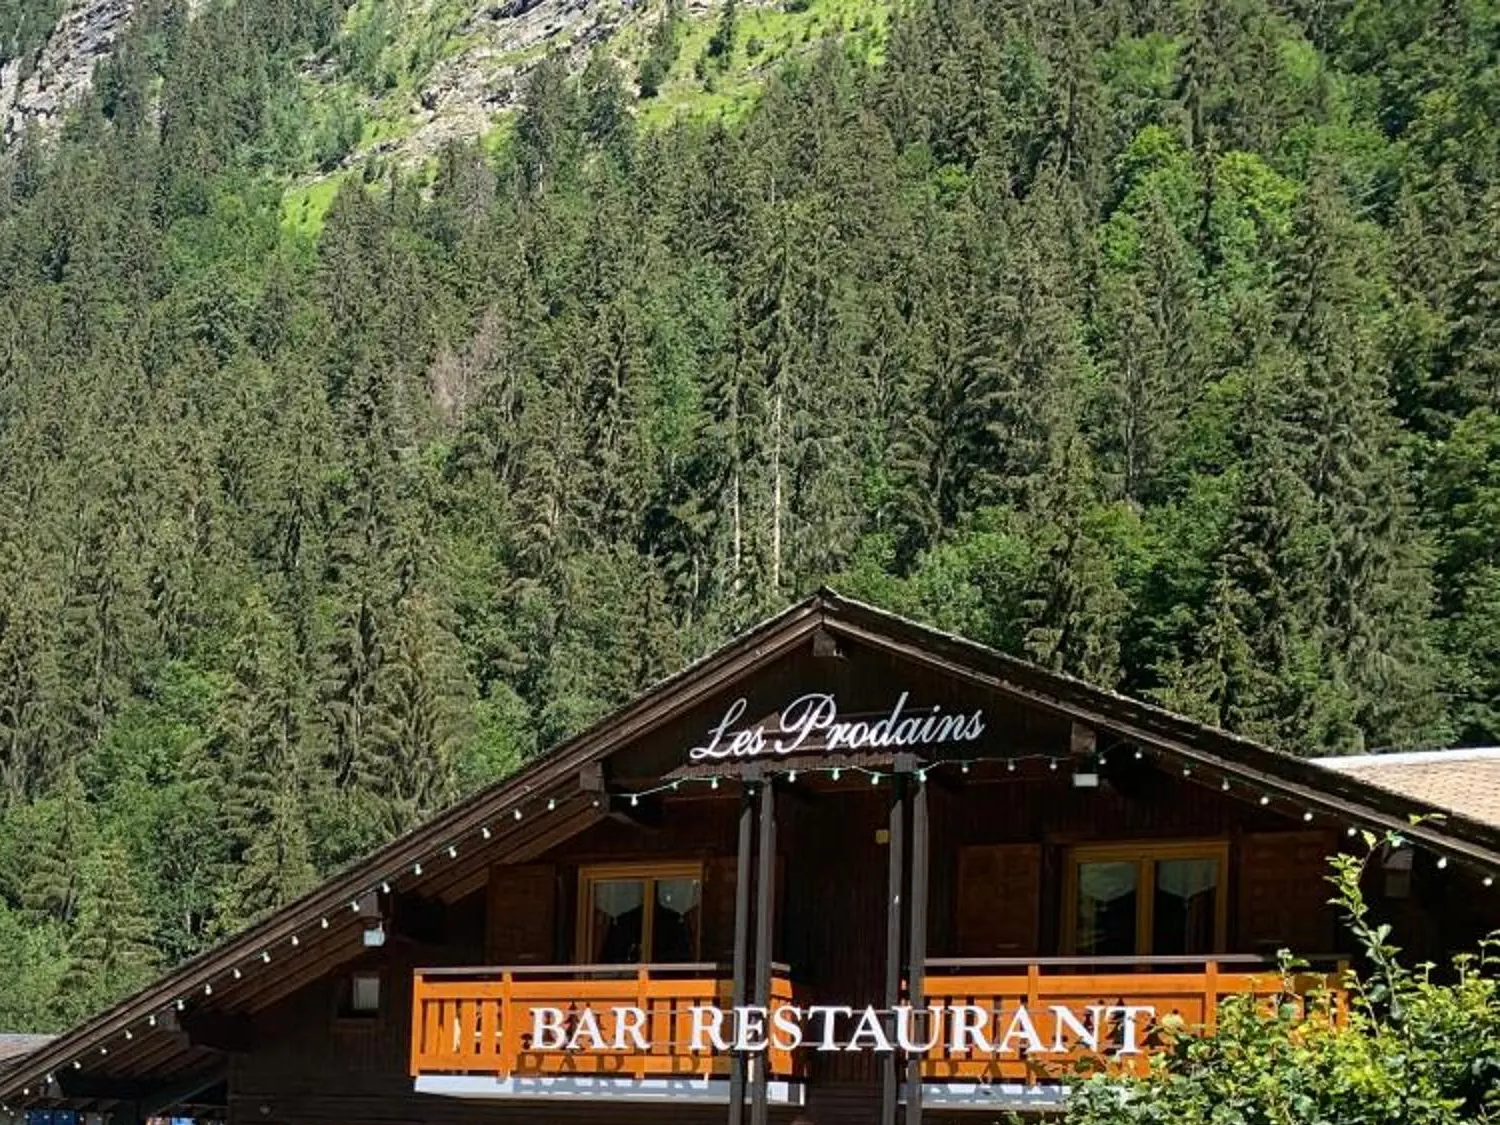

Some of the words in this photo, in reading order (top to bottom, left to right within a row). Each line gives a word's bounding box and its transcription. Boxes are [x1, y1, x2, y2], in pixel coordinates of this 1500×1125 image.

[689, 698, 768, 759] Les
[774, 691, 986, 753] Prodains
[529, 1006, 651, 1051] BAR
[687, 1004, 1155, 1055] RESTAURANT
